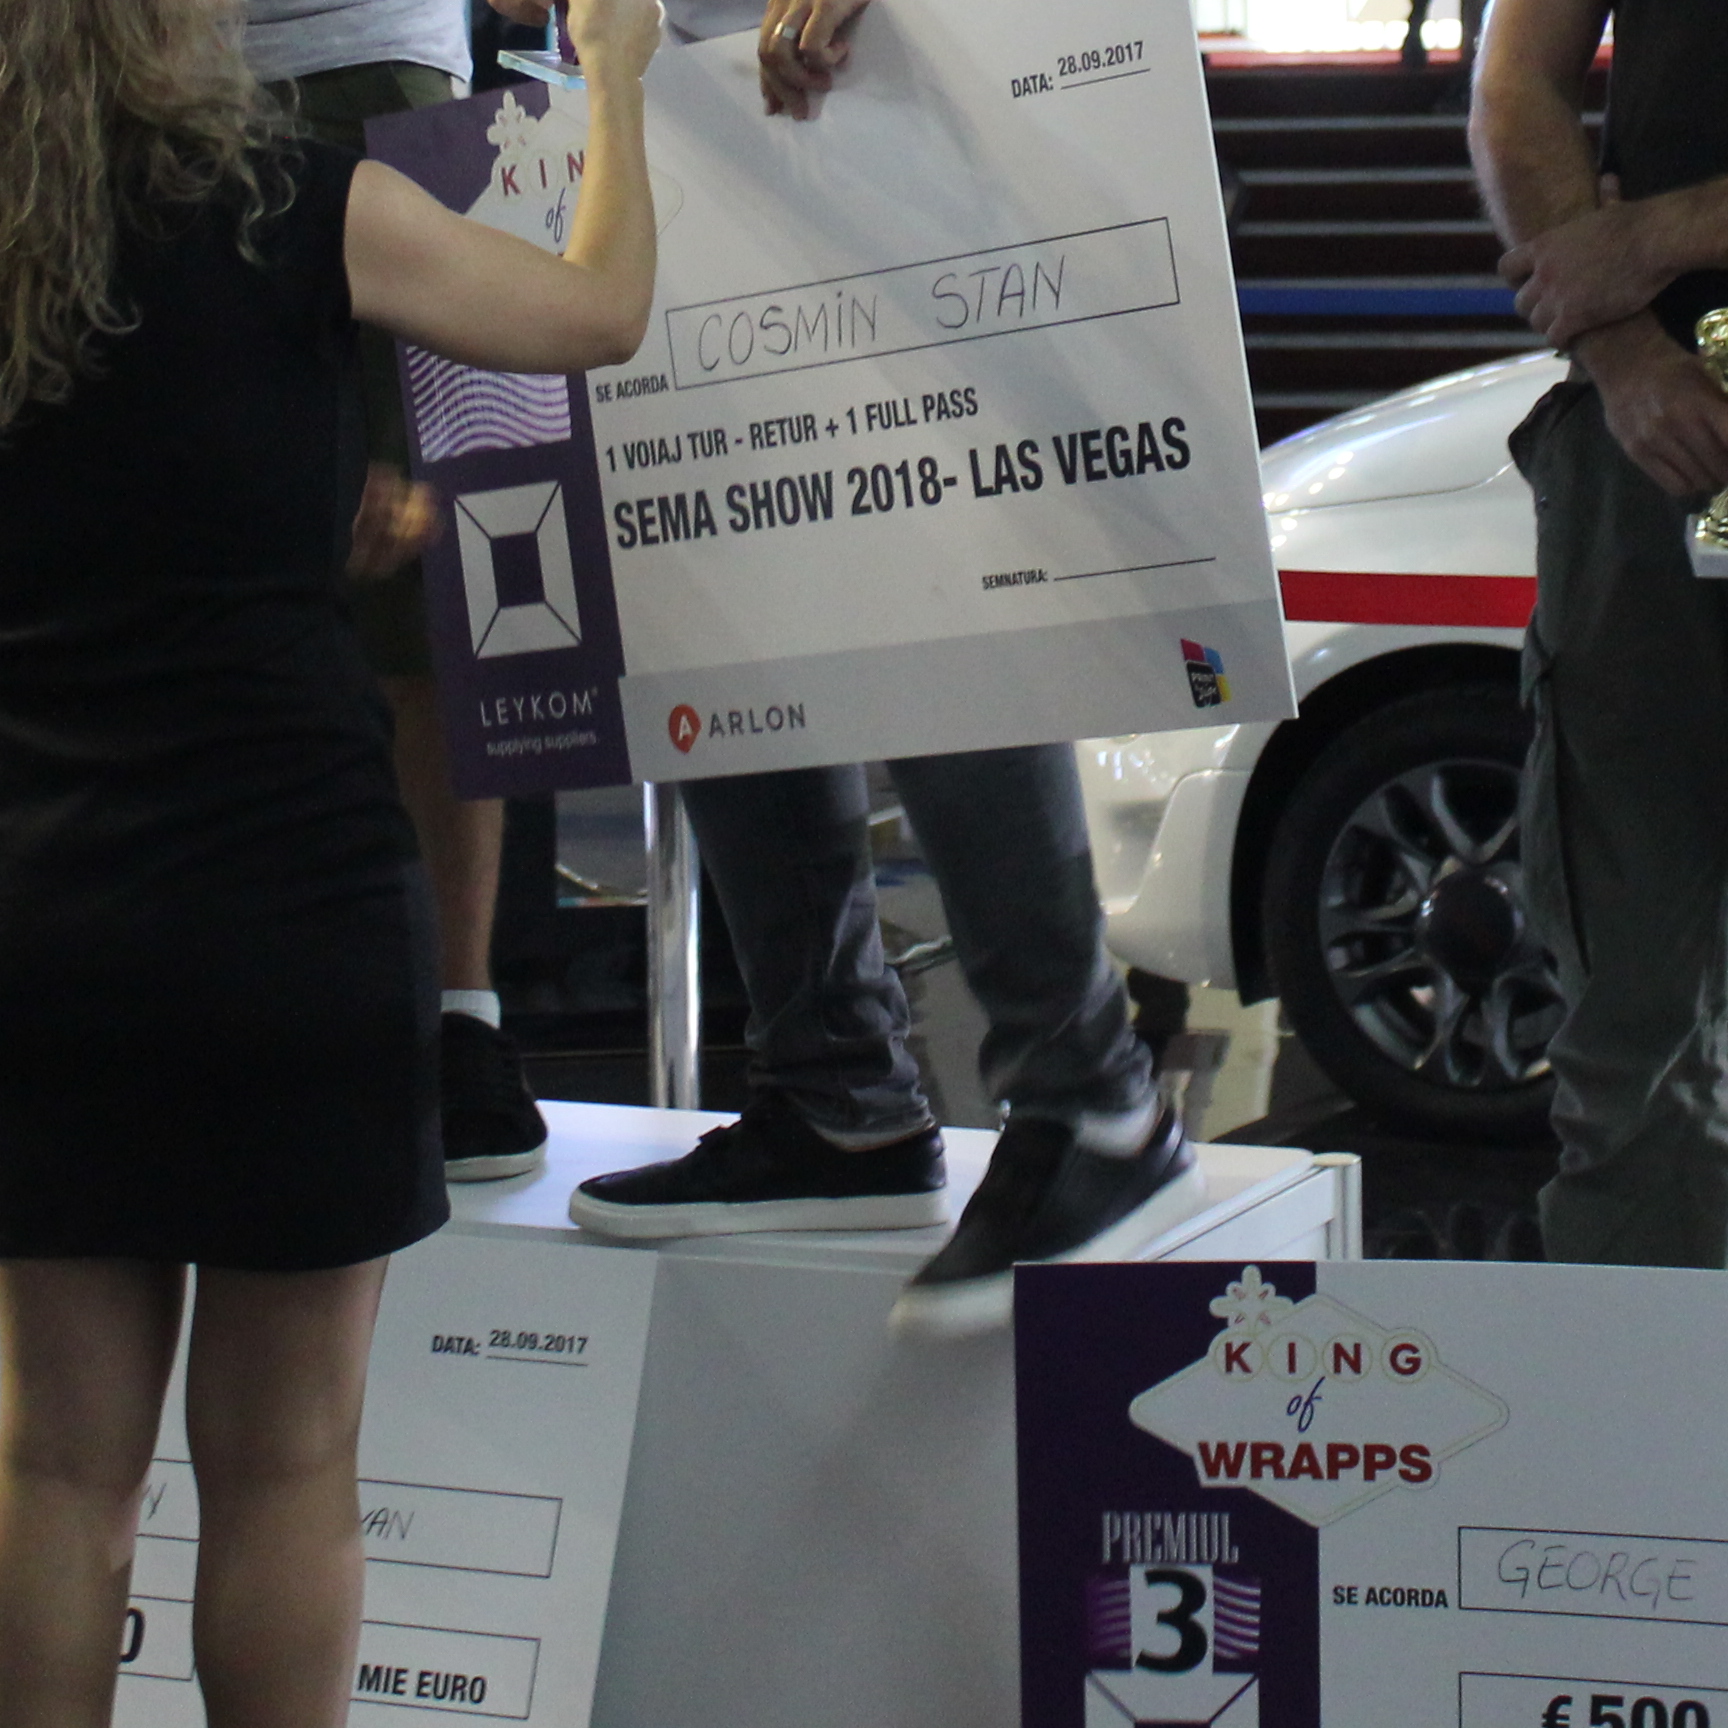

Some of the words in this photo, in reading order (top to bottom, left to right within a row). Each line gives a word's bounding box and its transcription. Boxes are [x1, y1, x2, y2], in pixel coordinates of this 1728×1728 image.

[1011, 73, 1055, 99] DATA:
[1057, 40, 1144, 77] 28.09.2017
[501, 150, 585, 196] KIN
[546, 187, 567, 243] of
[932, 255, 1066, 330] STAN
[596, 384, 614, 404] SE
[616, 373, 669, 400] ACORDA
[624, 440, 683, 471] VOIAJ
[688, 428, 729, 461] TUR
[750, 413, 819, 451] RETUR
[866, 398, 919, 433] FULL
[922, 386, 979, 425] PASS
[613, 487, 718, 551] SEMA
[726, 471, 835, 533] SHOW
[969, 438, 1045, 499] LAS
[1053, 415, 1192, 487] VEGAS
[709, 703, 807, 739] ARLON
[431, 1334, 480, 1356] DATA:
[488, 1329, 588, 1355] 28.09.2017
[1224, 1341, 1423, 1376] KING
[1286, 1375, 1326, 1433] of
[1198, 1441, 1434, 1485] WRAPPS
[1101, 1511, 1239, 1565] PREMIUL
[1332, 1585, 1359, 1606] SE
[1365, 1586, 1449, 1609] ACORDA
[1497, 1539, 1695, 1612] GEORGE
[1135, 1568, 1208, 1674] 3
[416, 1670, 488, 1705] EURO
